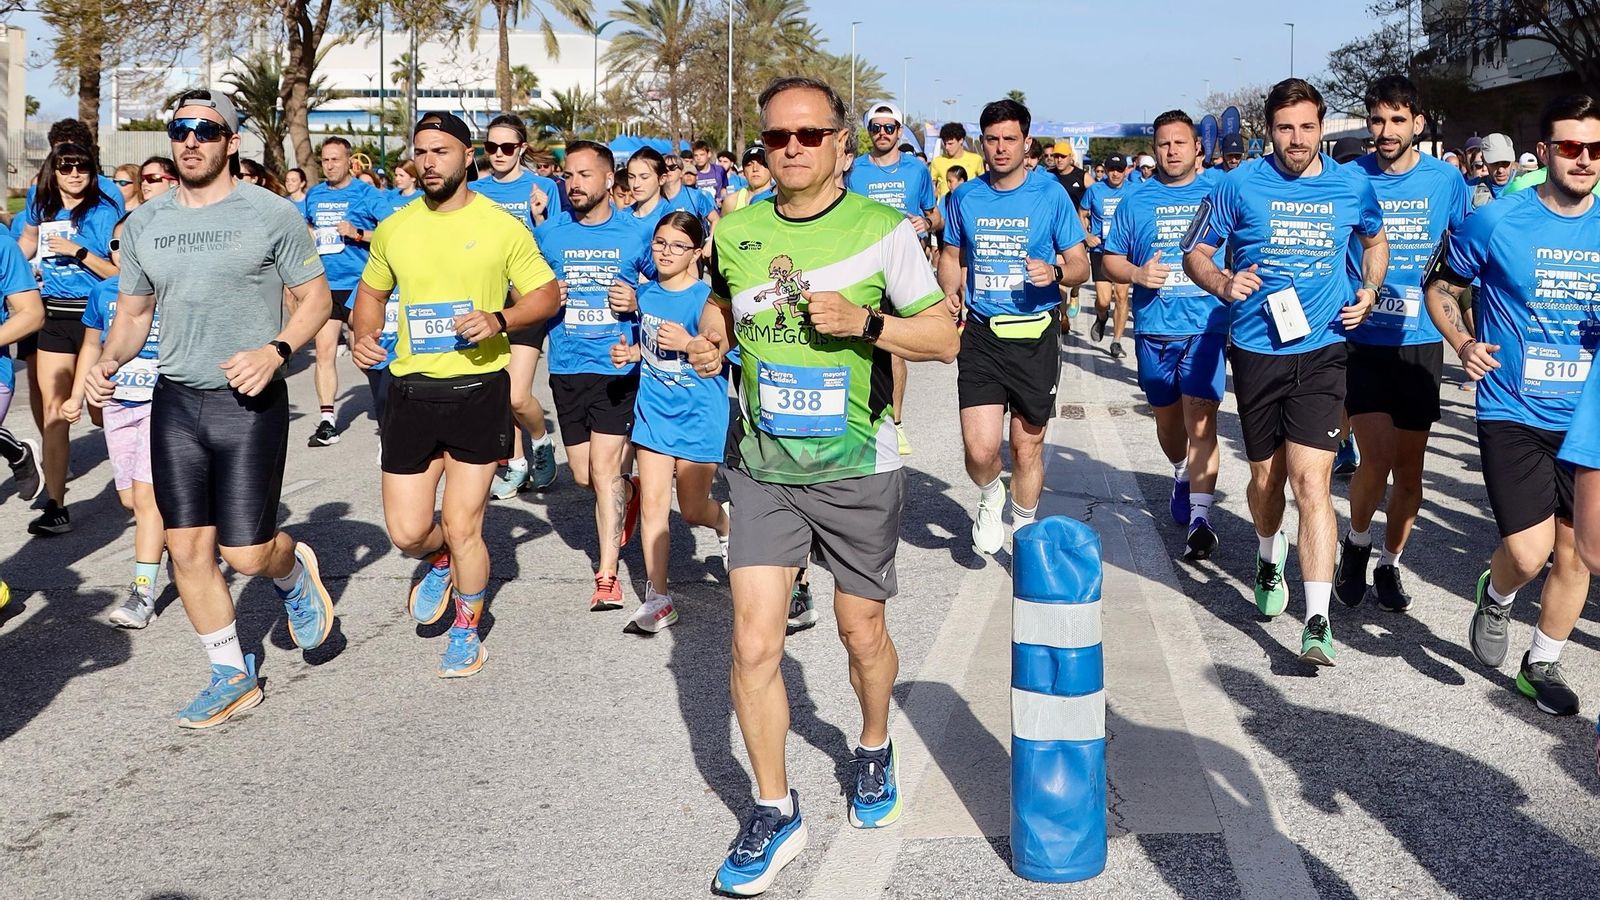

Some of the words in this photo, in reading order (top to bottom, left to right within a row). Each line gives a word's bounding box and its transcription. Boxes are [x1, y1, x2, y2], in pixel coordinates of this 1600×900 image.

[1062, 126, 1094, 134] mayoral
[868, 180, 905, 190] mayoral
[317, 201, 349, 210] mayoral
[1156, 205, 1200, 215] mayora
[1271, 201, 1333, 216] mayoral
[976, 217, 1029, 230] mayoral
[1269, 219, 1332, 231] RUNNING
[1384, 225, 1423, 233] AKES
[153, 235, 176, 250] TOP
[177, 230, 242, 246] RUNNERS
[1276, 228, 1326, 239] MAKES
[177, 246, 186, 254] IN
[189, 244, 206, 253] THE
[564, 248, 620, 261] mayoral
[1536, 248, 1600, 264] mayora
[984, 275, 1010, 288] 317
[1174, 272, 1190, 284] 58
[1541, 279, 1597, 292] MAKES
[1377, 297, 1405, 313] 702
[577, 310, 605, 322] 663
[425, 318, 456, 335] 664
[822, 370, 847, 379] mayoral
[1544, 361, 1578, 378] 810
[116, 371, 156, 386] 2762
[1524, 379, 1541, 387] 10KM
[777, 388, 822, 411] 388
[213, 634, 236, 648] DUN
